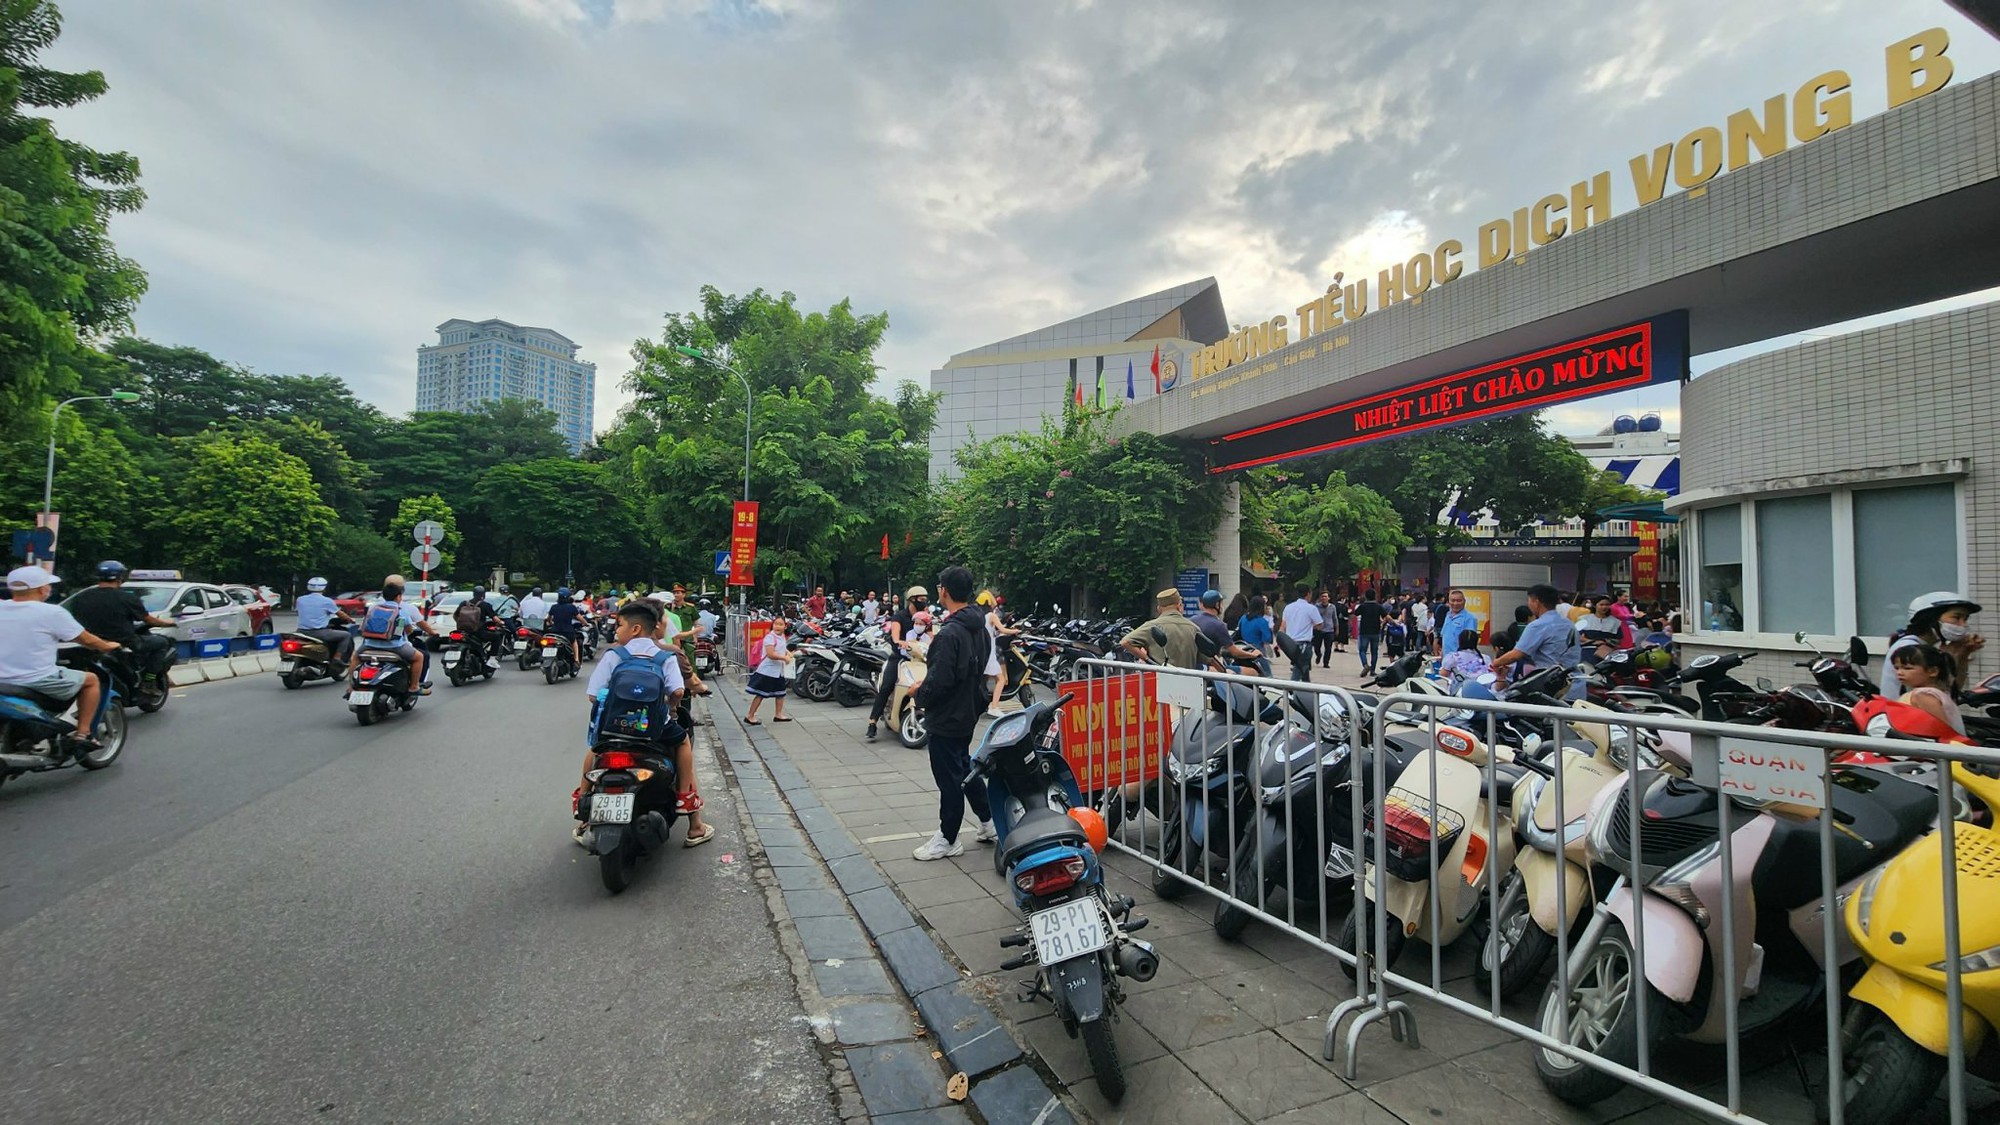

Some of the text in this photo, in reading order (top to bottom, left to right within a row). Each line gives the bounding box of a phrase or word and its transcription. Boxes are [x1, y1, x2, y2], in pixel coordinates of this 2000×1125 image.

[1188, 27, 1955, 381] TRƯỜNG TIỂU HỌC DỊCH VỌNG B
[1353, 398, 1415, 431] NHIỆT
[1418, 385, 1469, 417] LIỆT
[1473, 366, 1545, 404] CHÀO
[1041, 903, 1087, 935] 29-P1
[1041, 924, 1098, 961] 781.67
